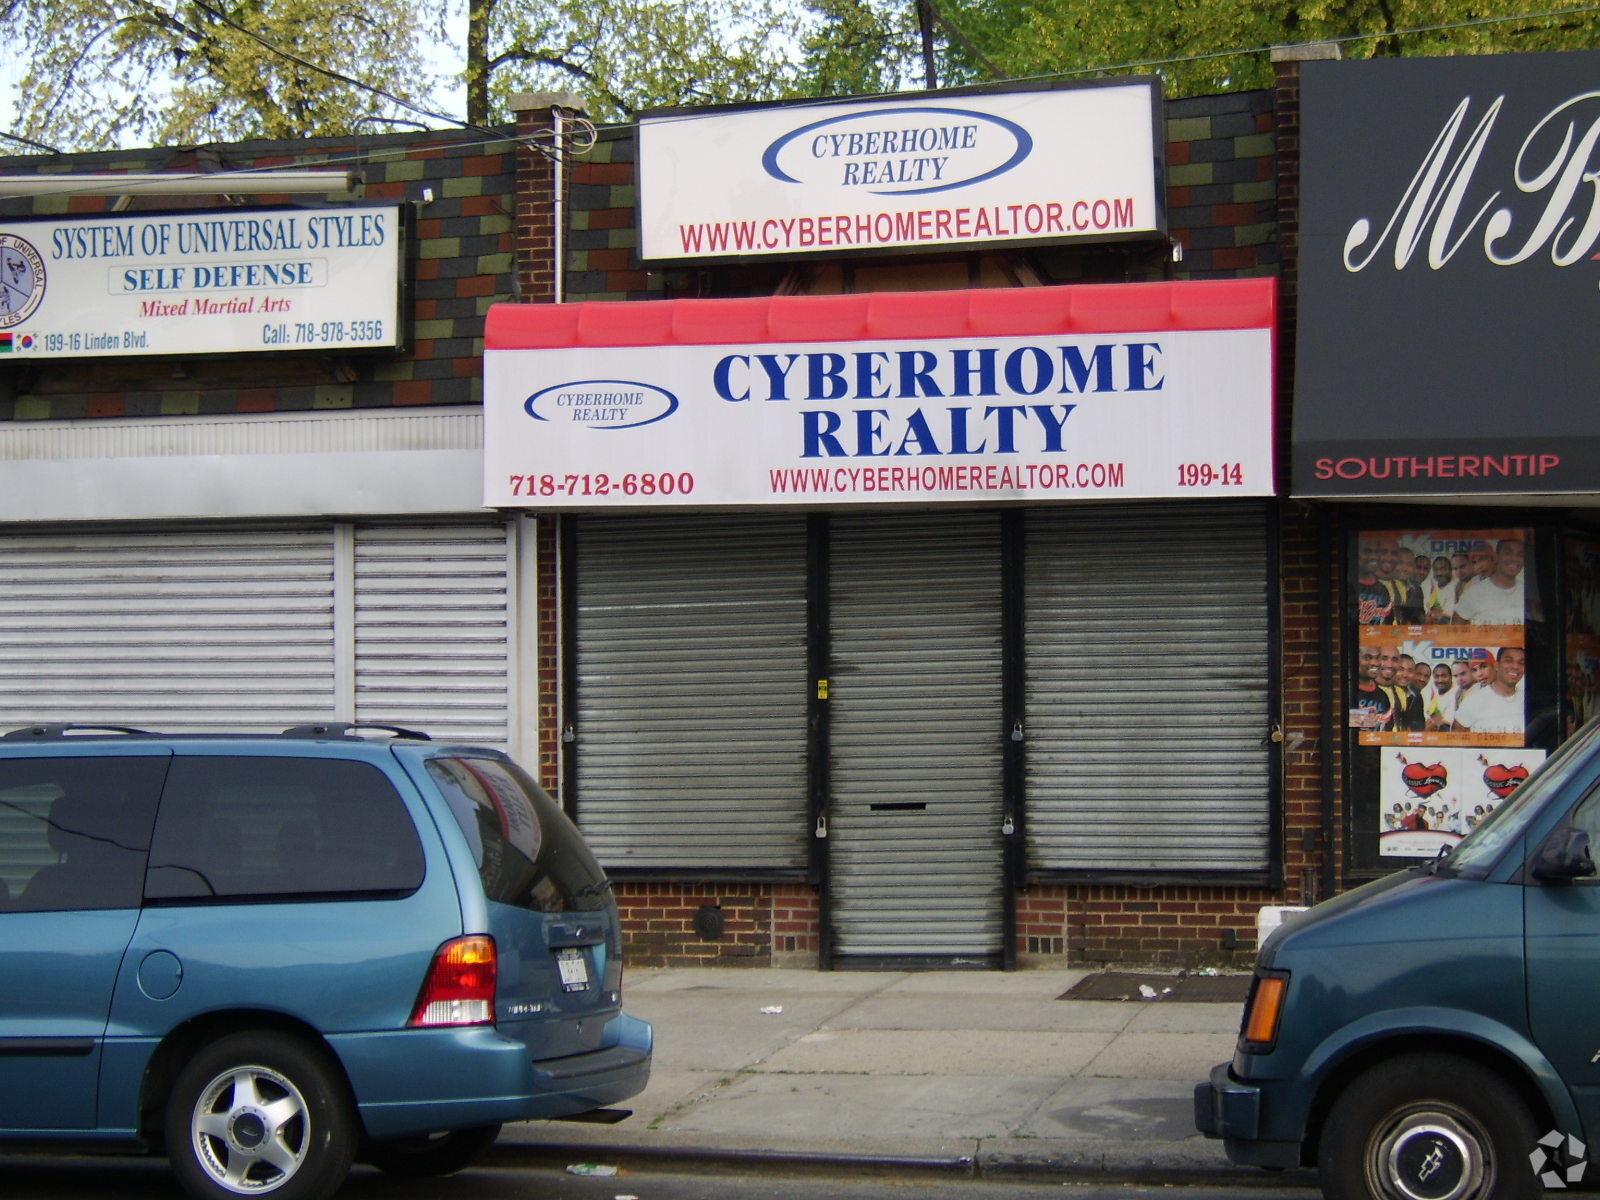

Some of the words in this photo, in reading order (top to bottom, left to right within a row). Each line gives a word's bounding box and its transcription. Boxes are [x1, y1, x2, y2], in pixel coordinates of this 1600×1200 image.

[811, 125, 978, 159] CYBERHOME
[841, 157, 949, 186] REALTY
[52, 225, 135, 260] SYSTEM
[142, 223, 171, 255] OF
[177, 218, 302, 253] UNIVERSAL
[307, 214, 385, 248] STYLES
[679, 198, 1135, 254] WWW.CYBERHOMEREALTOR.COM
[13, 239, 43, 289] UNIVERSAL
[123, 267, 186, 292] SELF
[192, 262, 313, 289] DEFENSE
[138, 299, 187, 318] Mixed
[191, 298, 254, 316] Martial
[257, 297, 292, 314] Arts
[44, 333, 81, 352] 199-16
[85, 332, 119, 350] Linden
[123, 331, 150, 349] Blvd.
[263, 323, 291, 345] Call:
[295, 320, 383, 343] 718-978-5356
[713, 342, 1165, 402] CYBERHOME
[557, 392, 644, 407] CYBERHOME
[572, 408, 629, 422] REALTY
[798, 404, 1077, 458] REALTY
[769, 463, 1125, 494] WWW.CYBERHOMEREALTOR.COM
[1177, 463, 1243, 487] 199-14
[1314, 454, 1561, 480] SOUTHERNTIP
[509, 472, 694, 497] 718-712-6800
